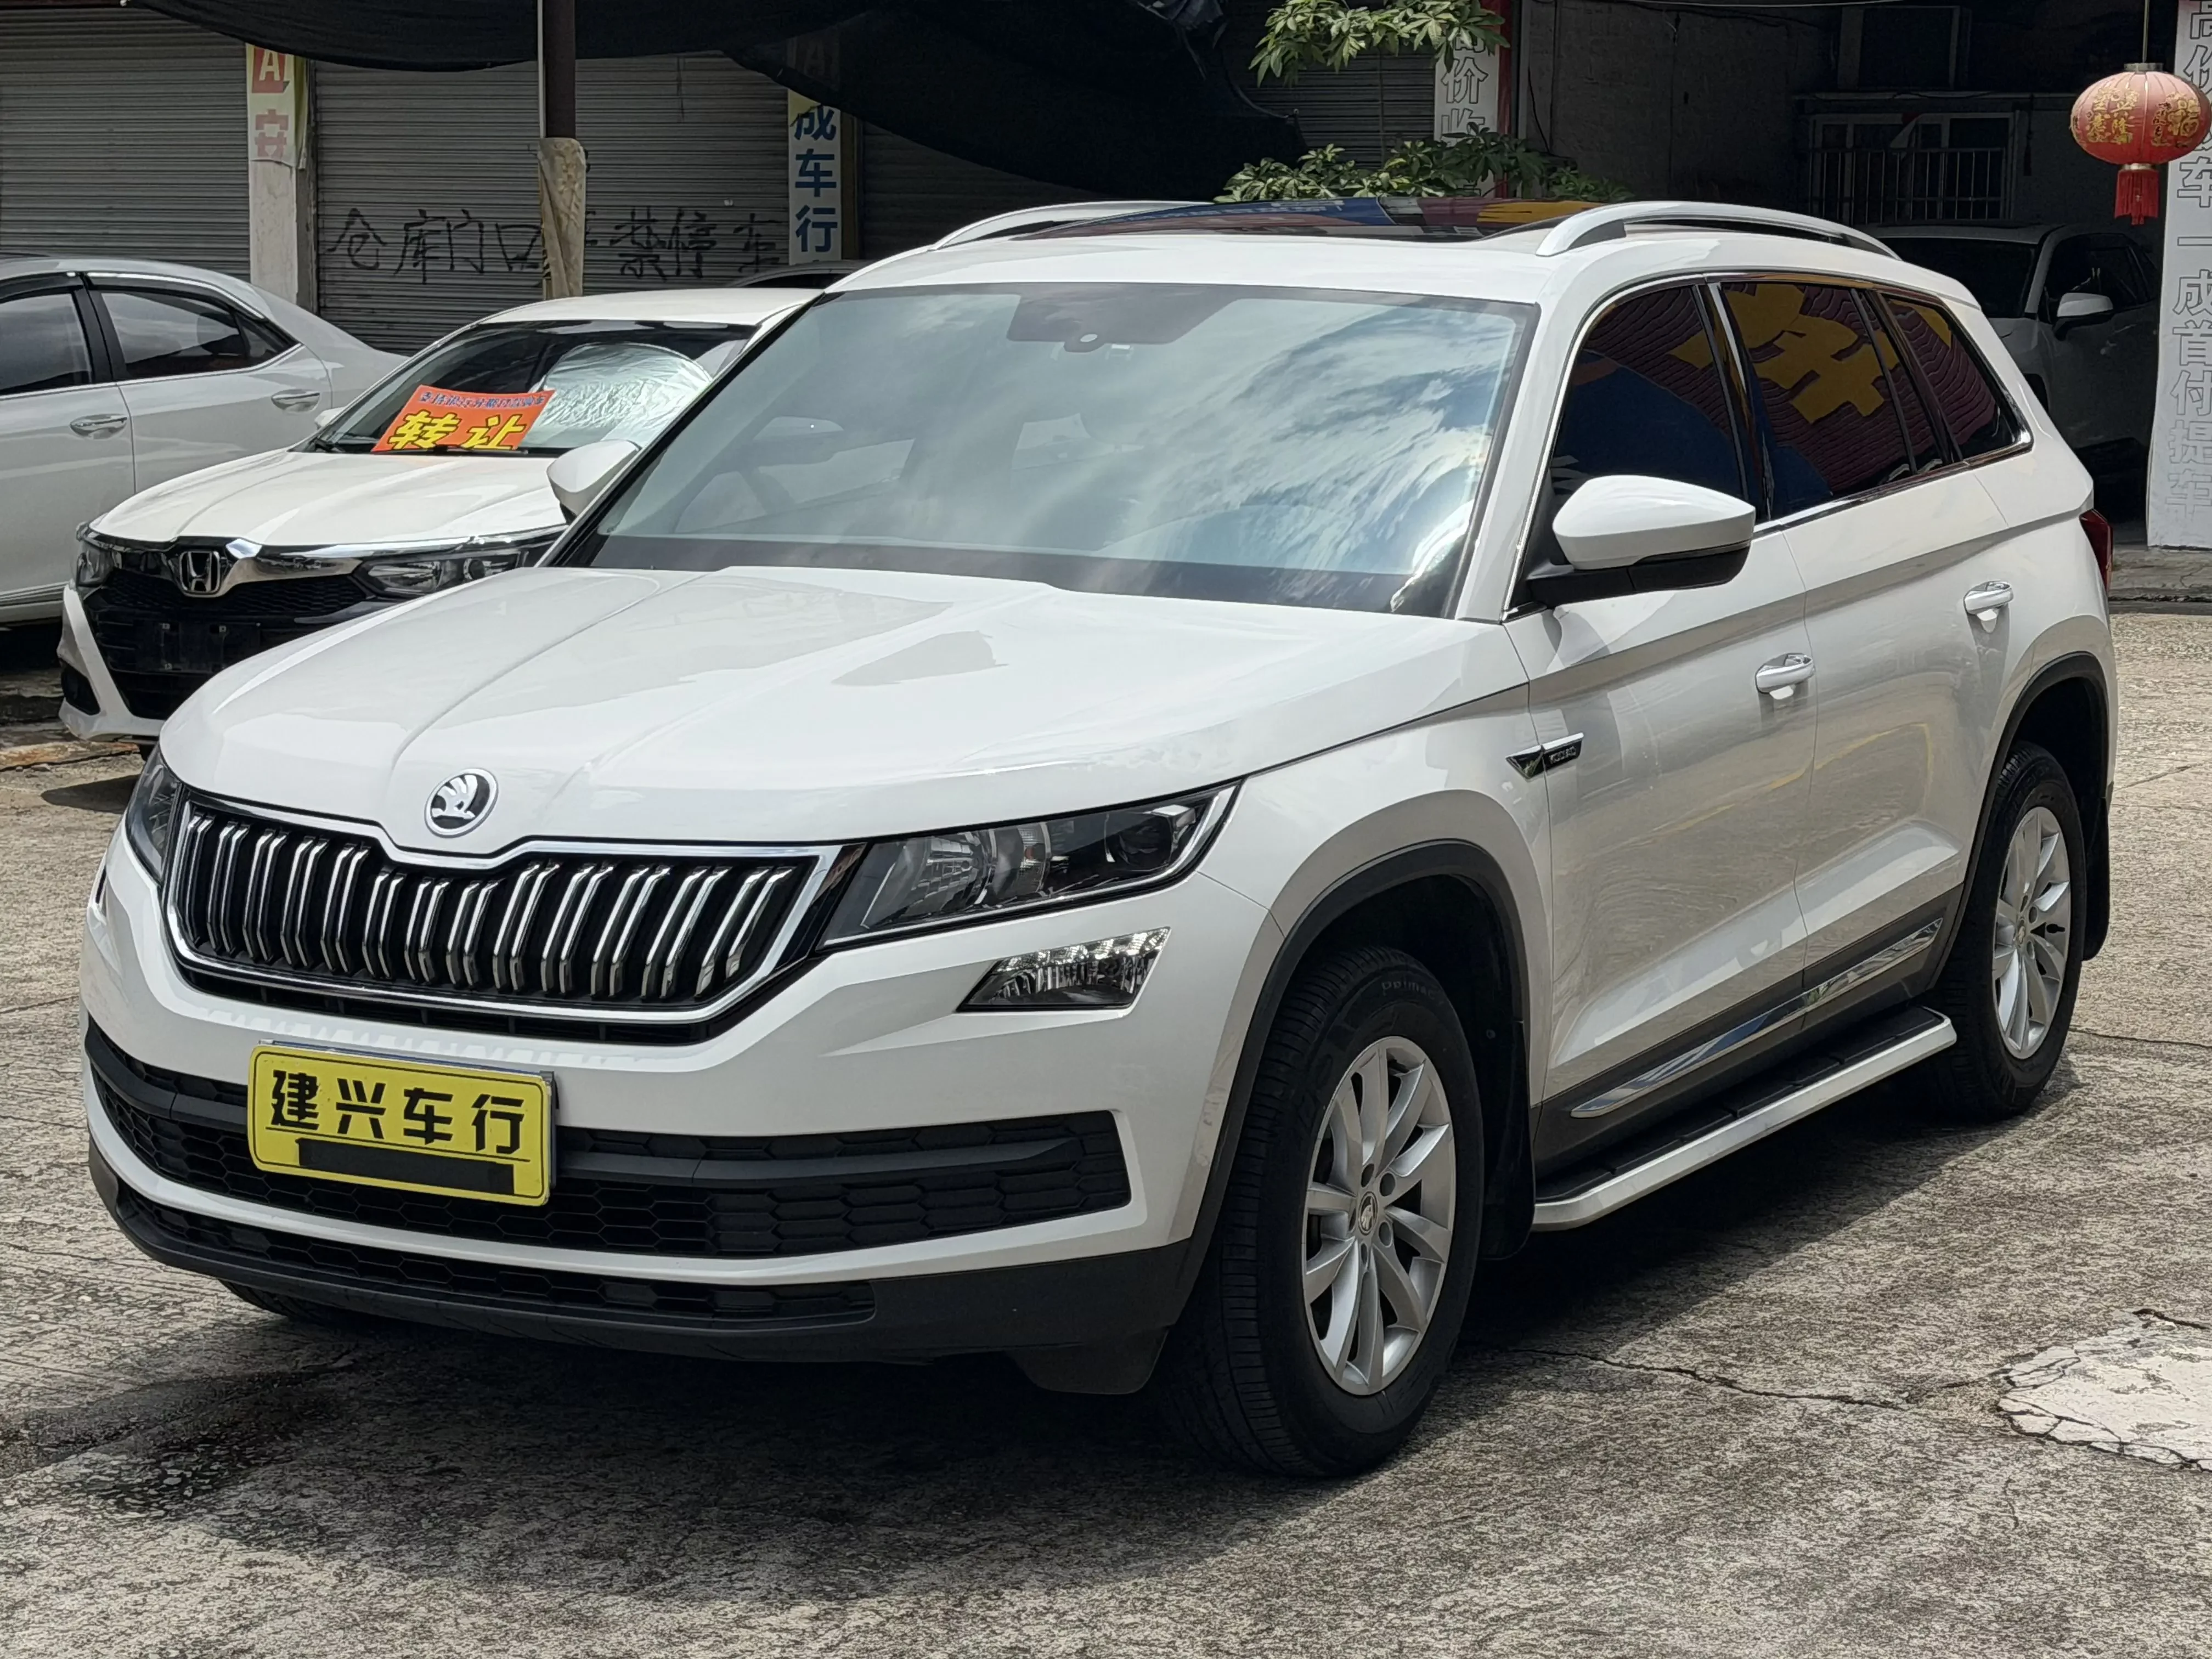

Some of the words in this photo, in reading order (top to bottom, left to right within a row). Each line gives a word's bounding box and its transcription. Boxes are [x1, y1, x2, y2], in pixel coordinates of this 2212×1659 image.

[328, 206, 782, 285] 仓库门口禁停车
[387, 409, 527, 450] 转让
[270, 1070, 525, 1154] 建兴车行
